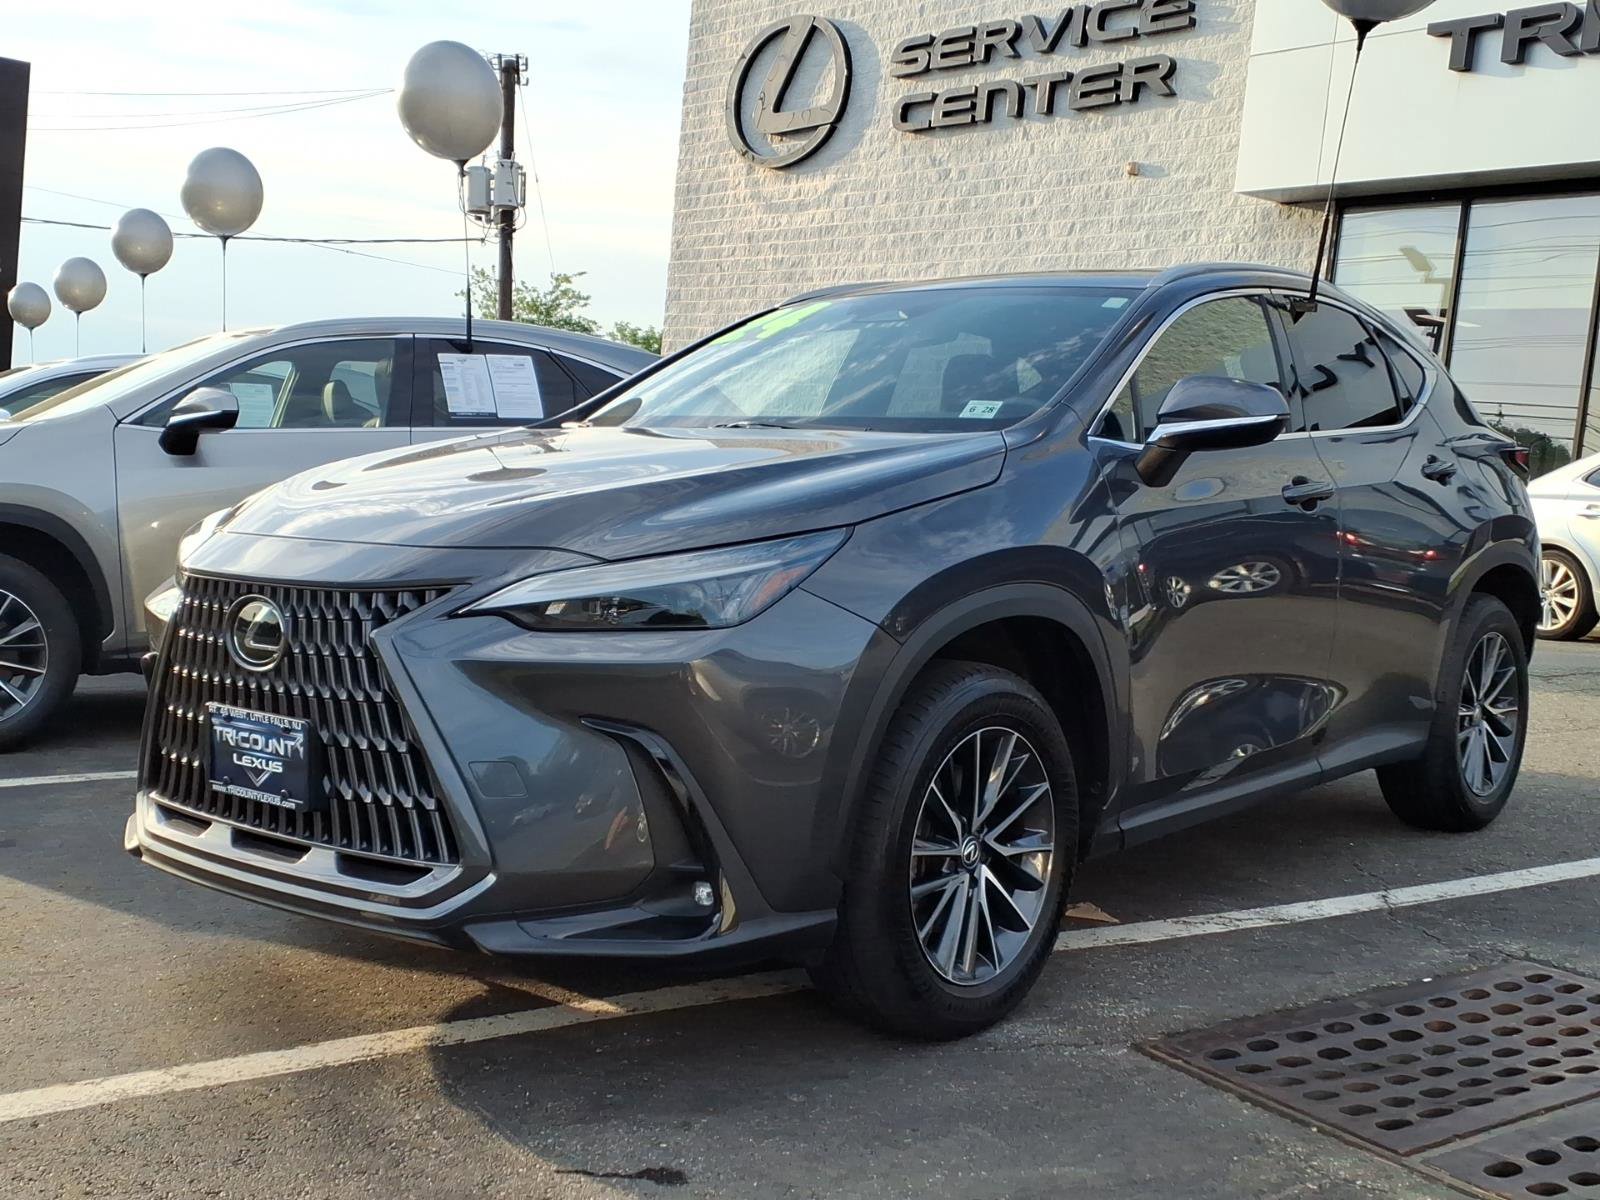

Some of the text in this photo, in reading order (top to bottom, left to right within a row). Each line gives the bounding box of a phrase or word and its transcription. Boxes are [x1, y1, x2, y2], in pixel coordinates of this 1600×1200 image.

[891, 0, 1195, 78] SERVICE
[892, 54, 1177, 132] CENTER
[250, 712, 270, 724] LITTLE
[292, 720, 302, 730] NJ
[233, 753, 283, 773] LEXUS
